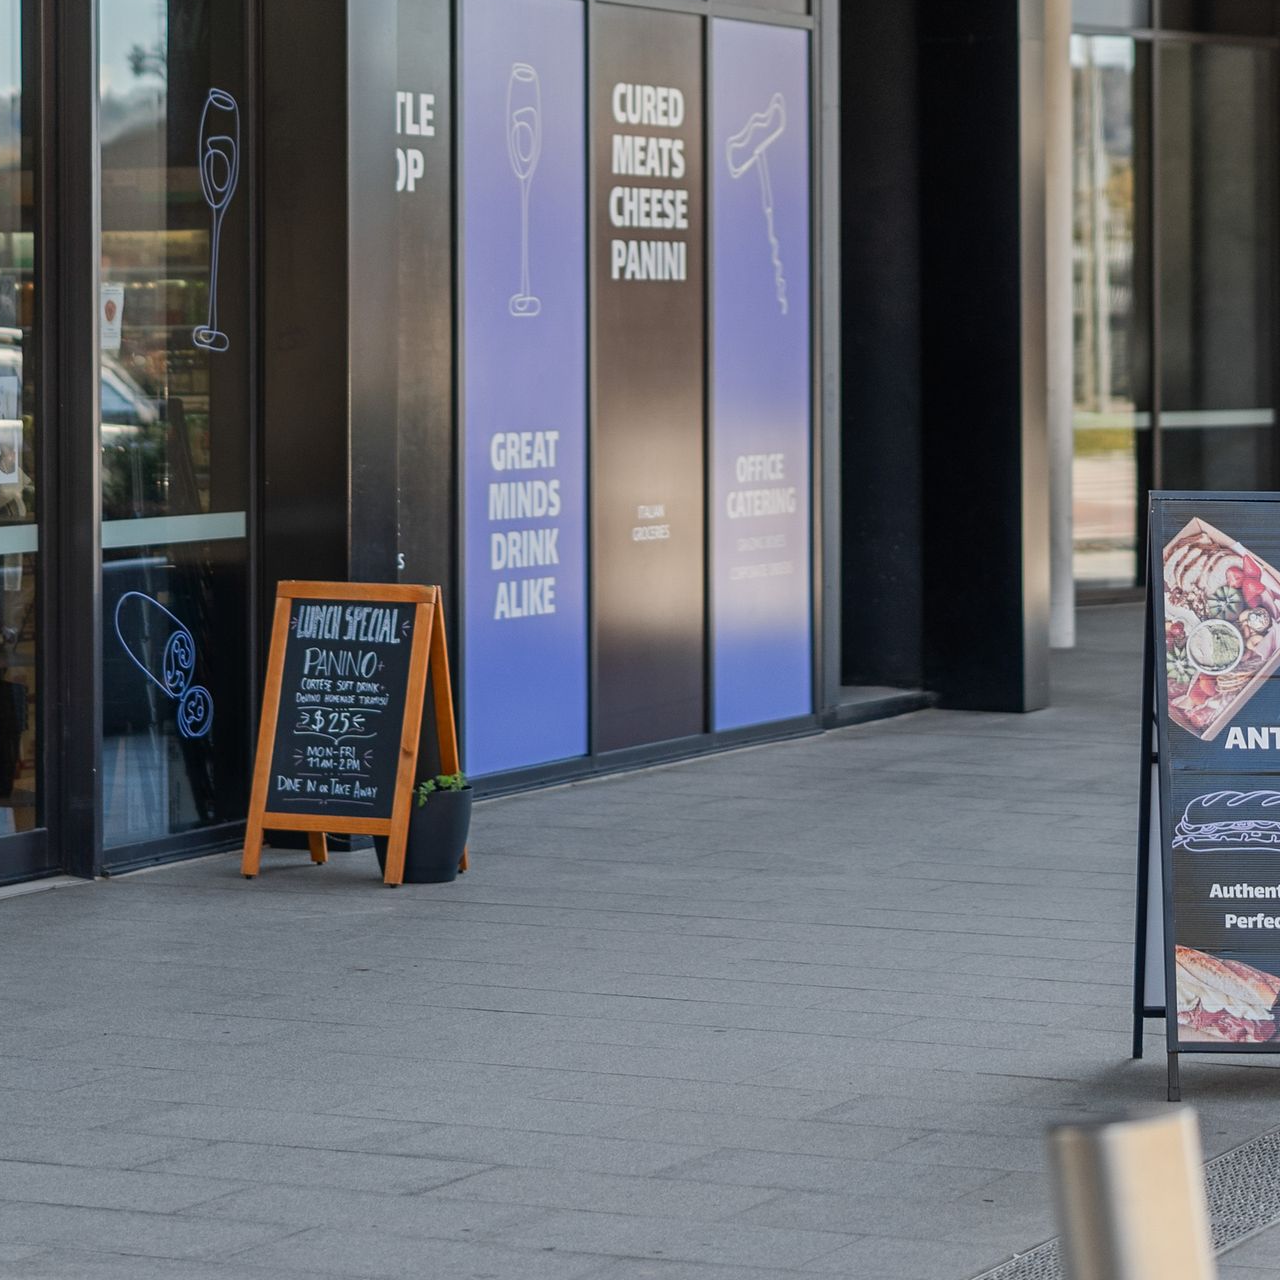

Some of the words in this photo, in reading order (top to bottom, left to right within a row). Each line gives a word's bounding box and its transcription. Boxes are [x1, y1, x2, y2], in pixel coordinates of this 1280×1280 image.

[612, 82, 685, 127] CURED
[612, 134, 685, 179] MEATS
[609, 186, 688, 229] CHEESE
[611, 239, 686, 281] PANINI
[491, 431, 559, 471] GREAT
[736, 453, 785, 483] OFFICE
[488, 479, 560, 521] MINDS
[726, 487, 797, 519] CATERING
[491, 528, 559, 570] DRINK
[494, 576, 556, 621] ALIKE
[296, 605, 342, 639] LUNCH
[342, 606, 401, 644] SPECIAL
[324, 694, 356, 704] HOMEMADE
[337, 680, 354, 692] SOFT
[277, 775, 303, 792] DINE
[330, 778, 351, 795] TAKE
[353, 780, 378, 798] AWAY
